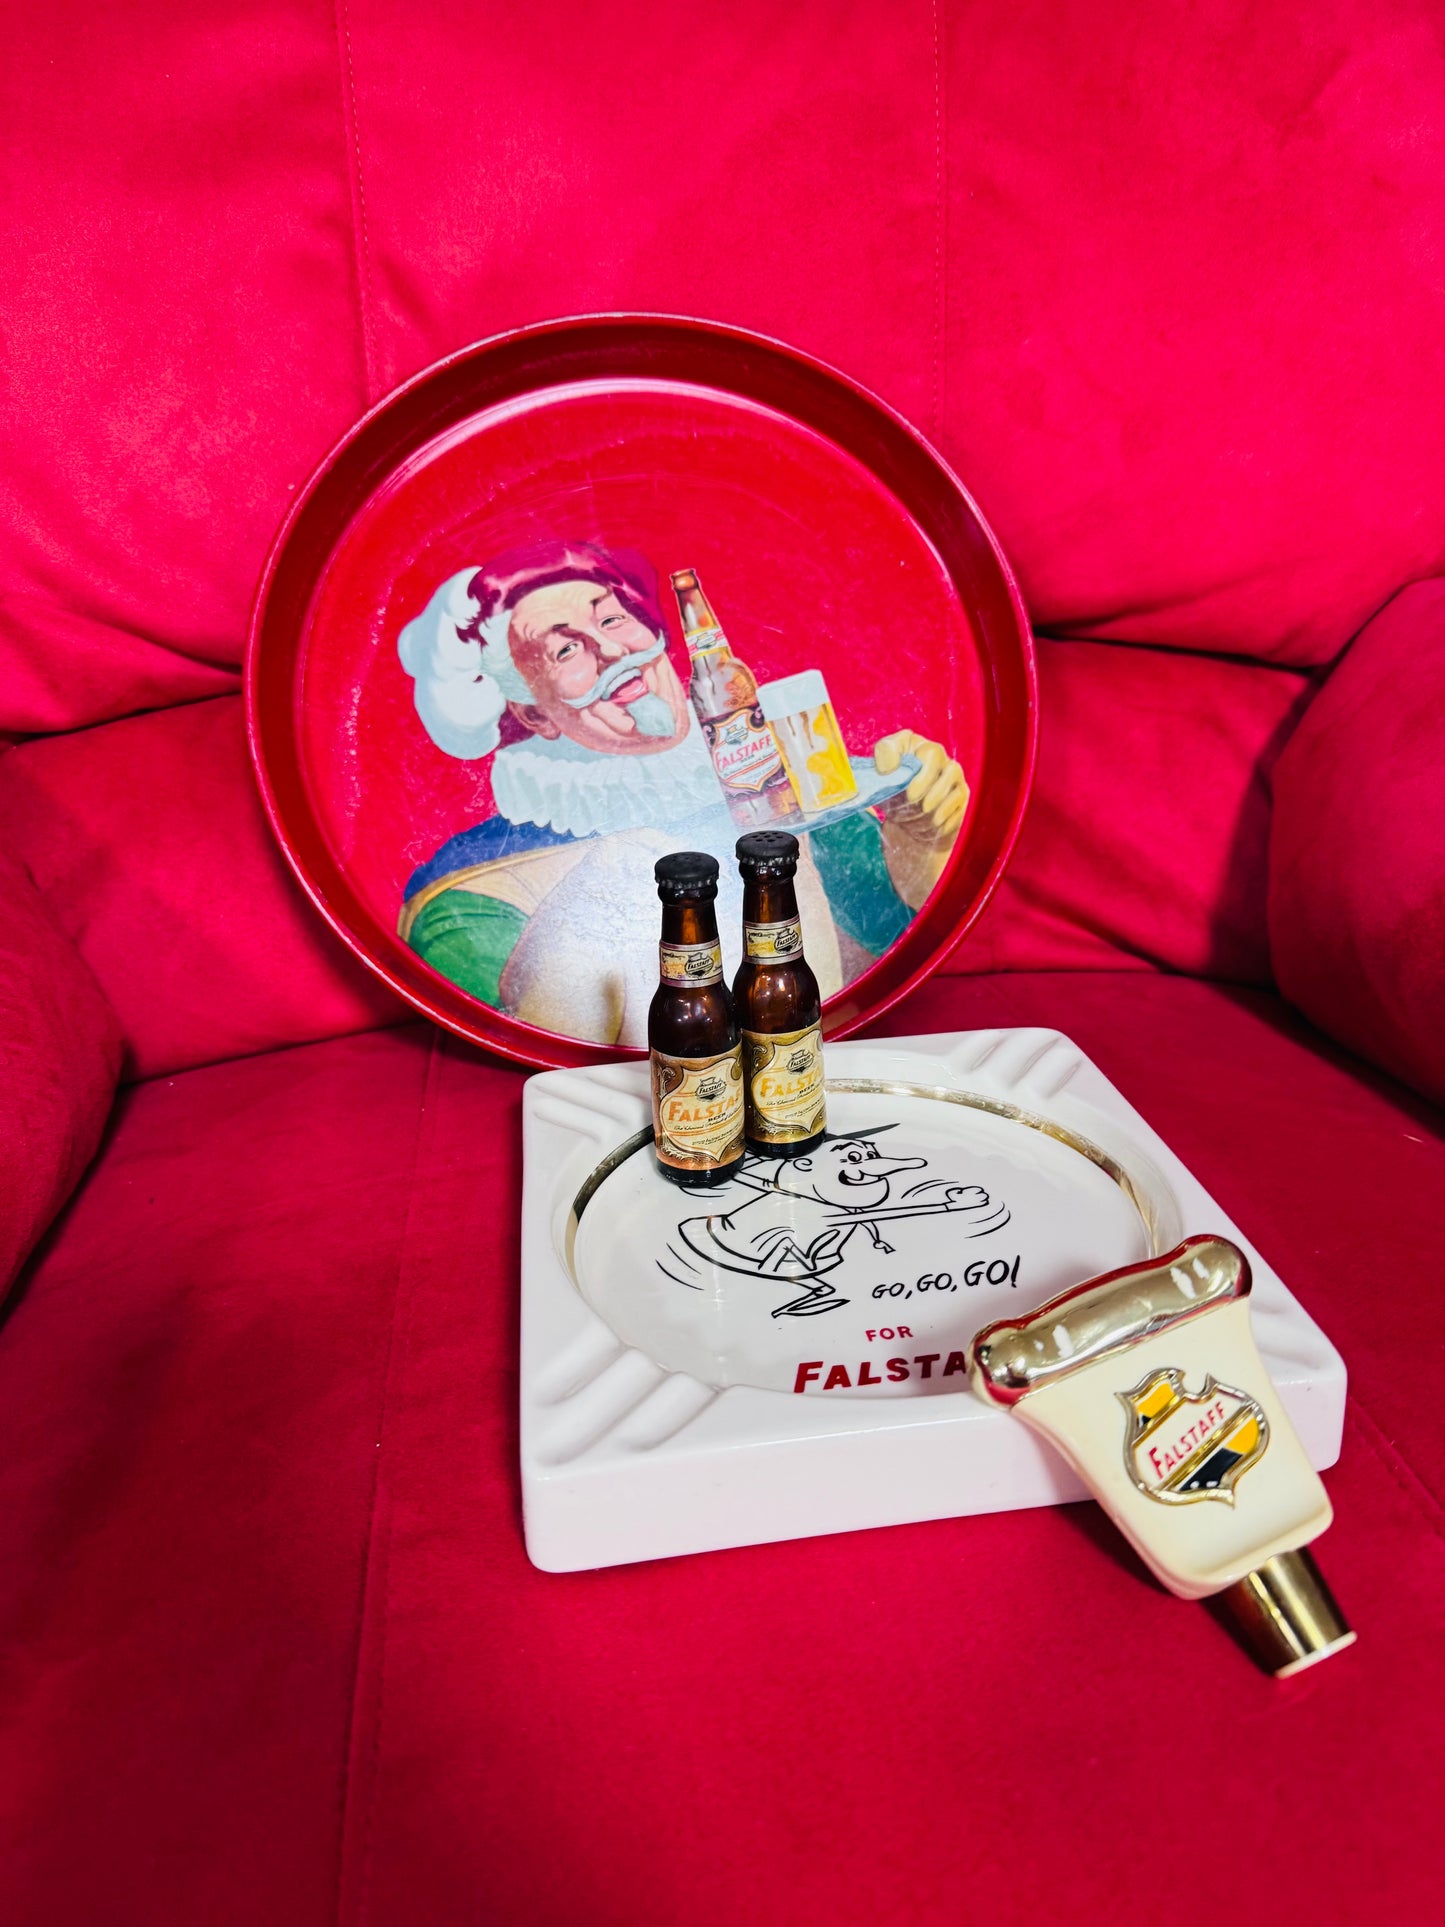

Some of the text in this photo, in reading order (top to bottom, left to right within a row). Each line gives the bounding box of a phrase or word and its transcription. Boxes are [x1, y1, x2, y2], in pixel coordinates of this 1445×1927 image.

[715, 734, 771, 771] FALSTAFF
[688, 958, 710, 970] FALSTAFF
[699, 1083, 722, 1094] FALSTAFF
[760, 1067, 820, 1098] FALSTA
[668, 1087, 742, 1122] FALSTAF
[872, 1254, 1021, 1300] GO, GO, GO!
[865, 1325, 914, 1342] FOR
[793, 1350, 967, 1394] FALSTA
[1147, 1401, 1225, 1480] FALSTAFF
